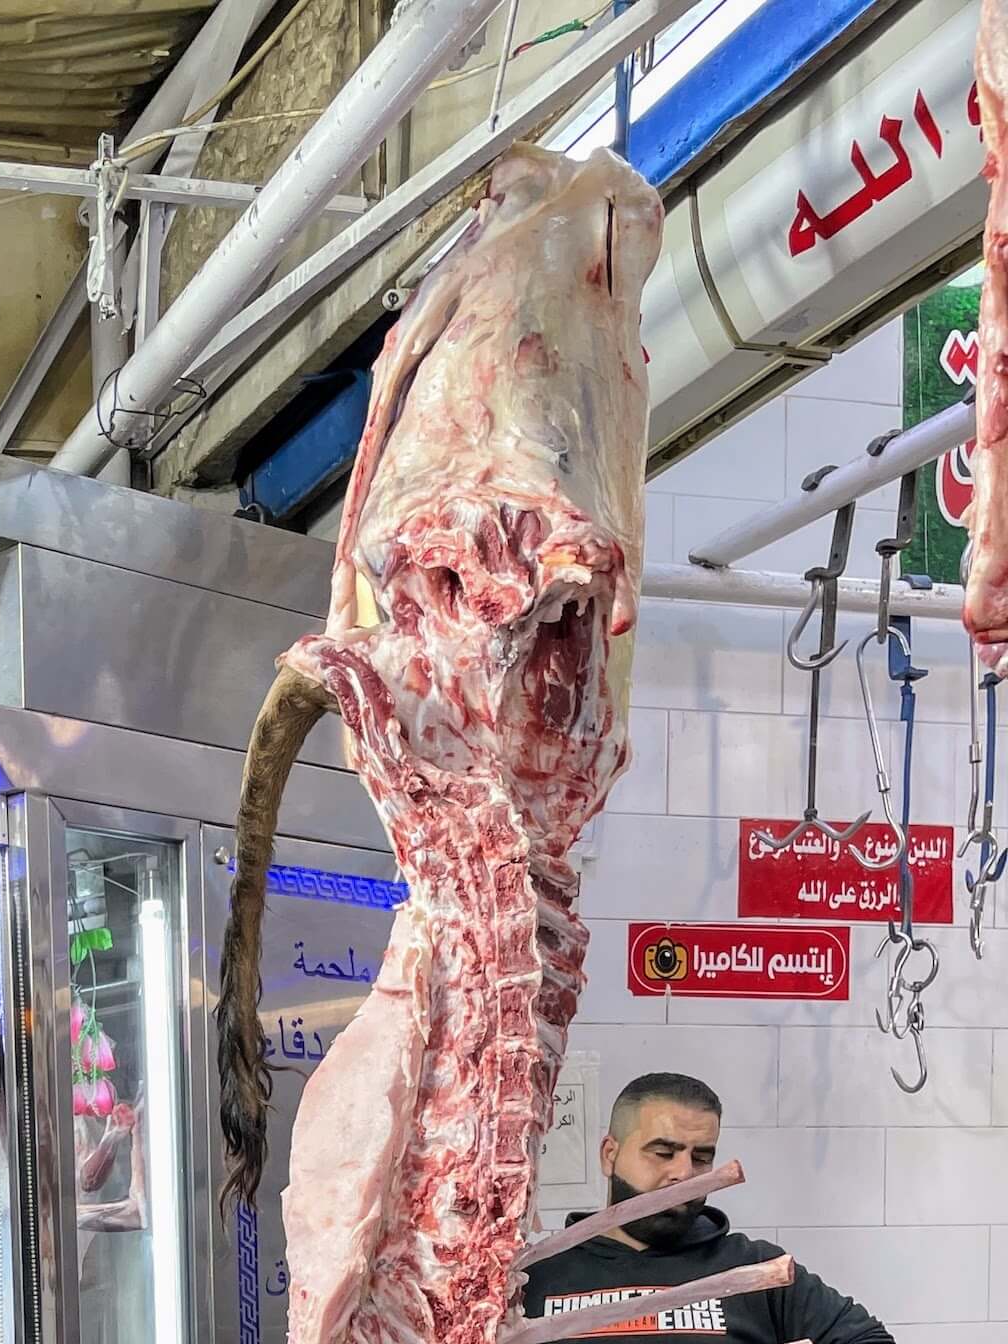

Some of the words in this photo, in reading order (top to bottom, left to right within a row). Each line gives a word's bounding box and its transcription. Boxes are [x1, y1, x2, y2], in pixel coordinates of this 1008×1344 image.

[788, 88, 943, 258] الله
[865, 834, 899, 863] منوع
[908, 836, 947, 866] الدين
[798, 879, 827, 903] الله
[829, 881, 856, 910] على
[293, 941, 371, 983] ملحمة
[693, 943, 763, 979] للكاميرا
[768, 947, 834, 986] إبتسم
[657, 1309, 728, 1331] EDGE
